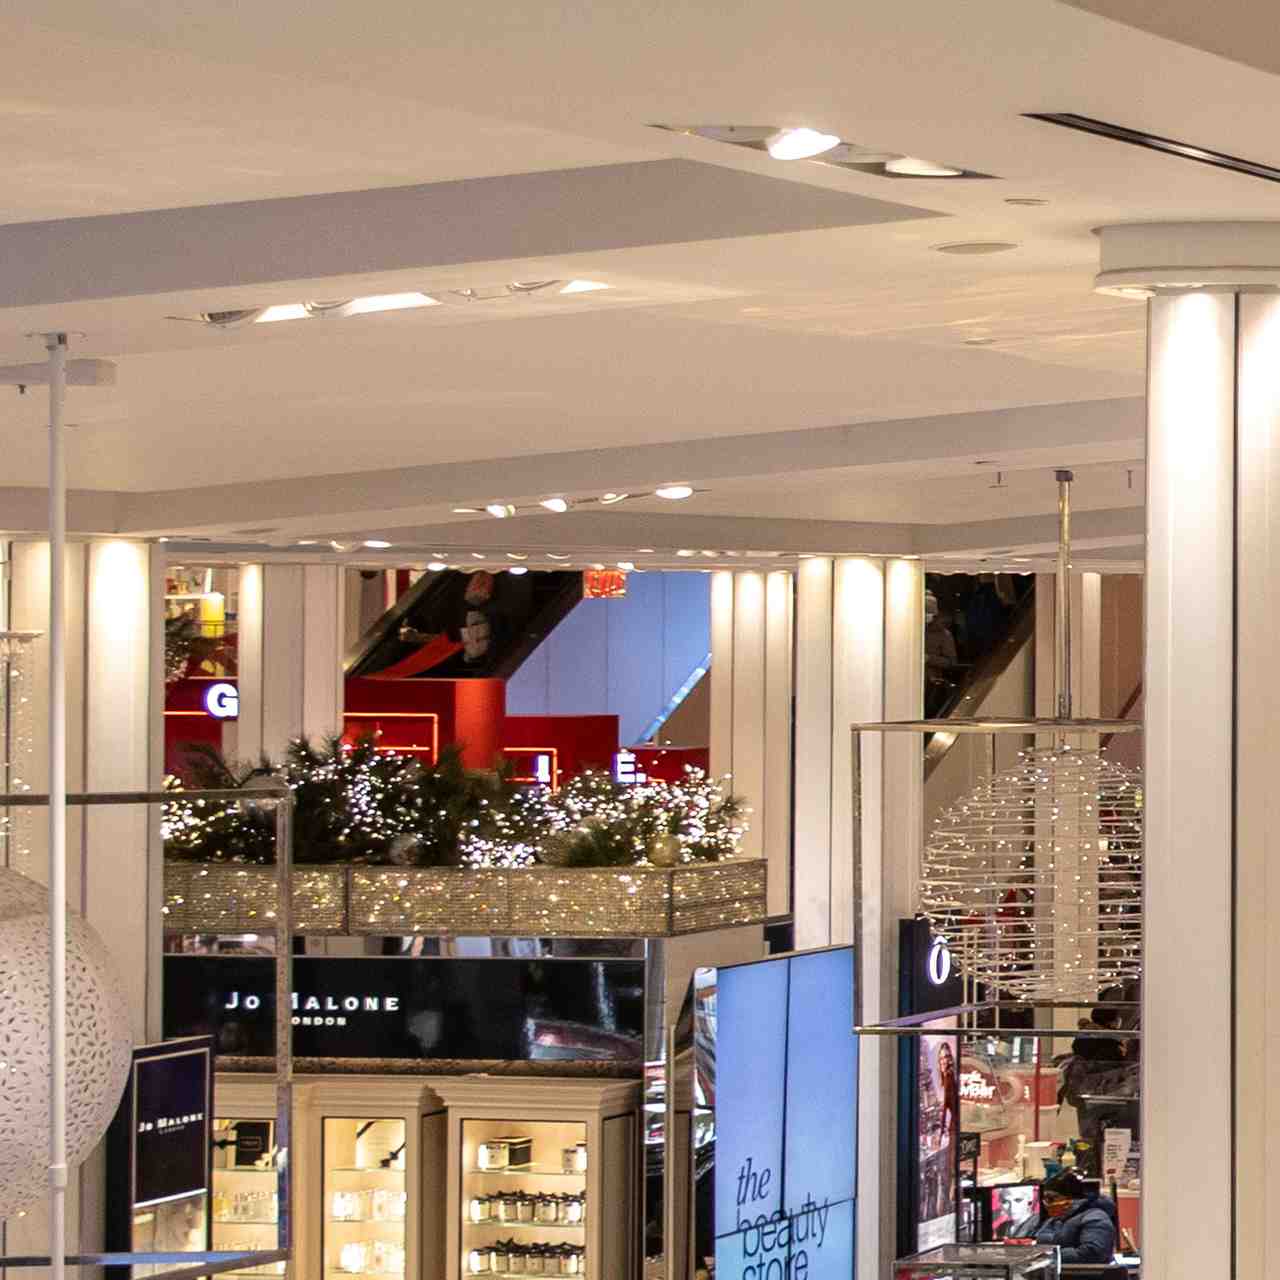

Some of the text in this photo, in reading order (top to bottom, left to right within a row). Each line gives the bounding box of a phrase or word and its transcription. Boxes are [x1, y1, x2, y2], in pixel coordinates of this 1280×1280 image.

[291, 1015, 347, 1026] ONDON
[737, 1157, 772, 1206] the
[737, 1192, 829, 1259] beauty
